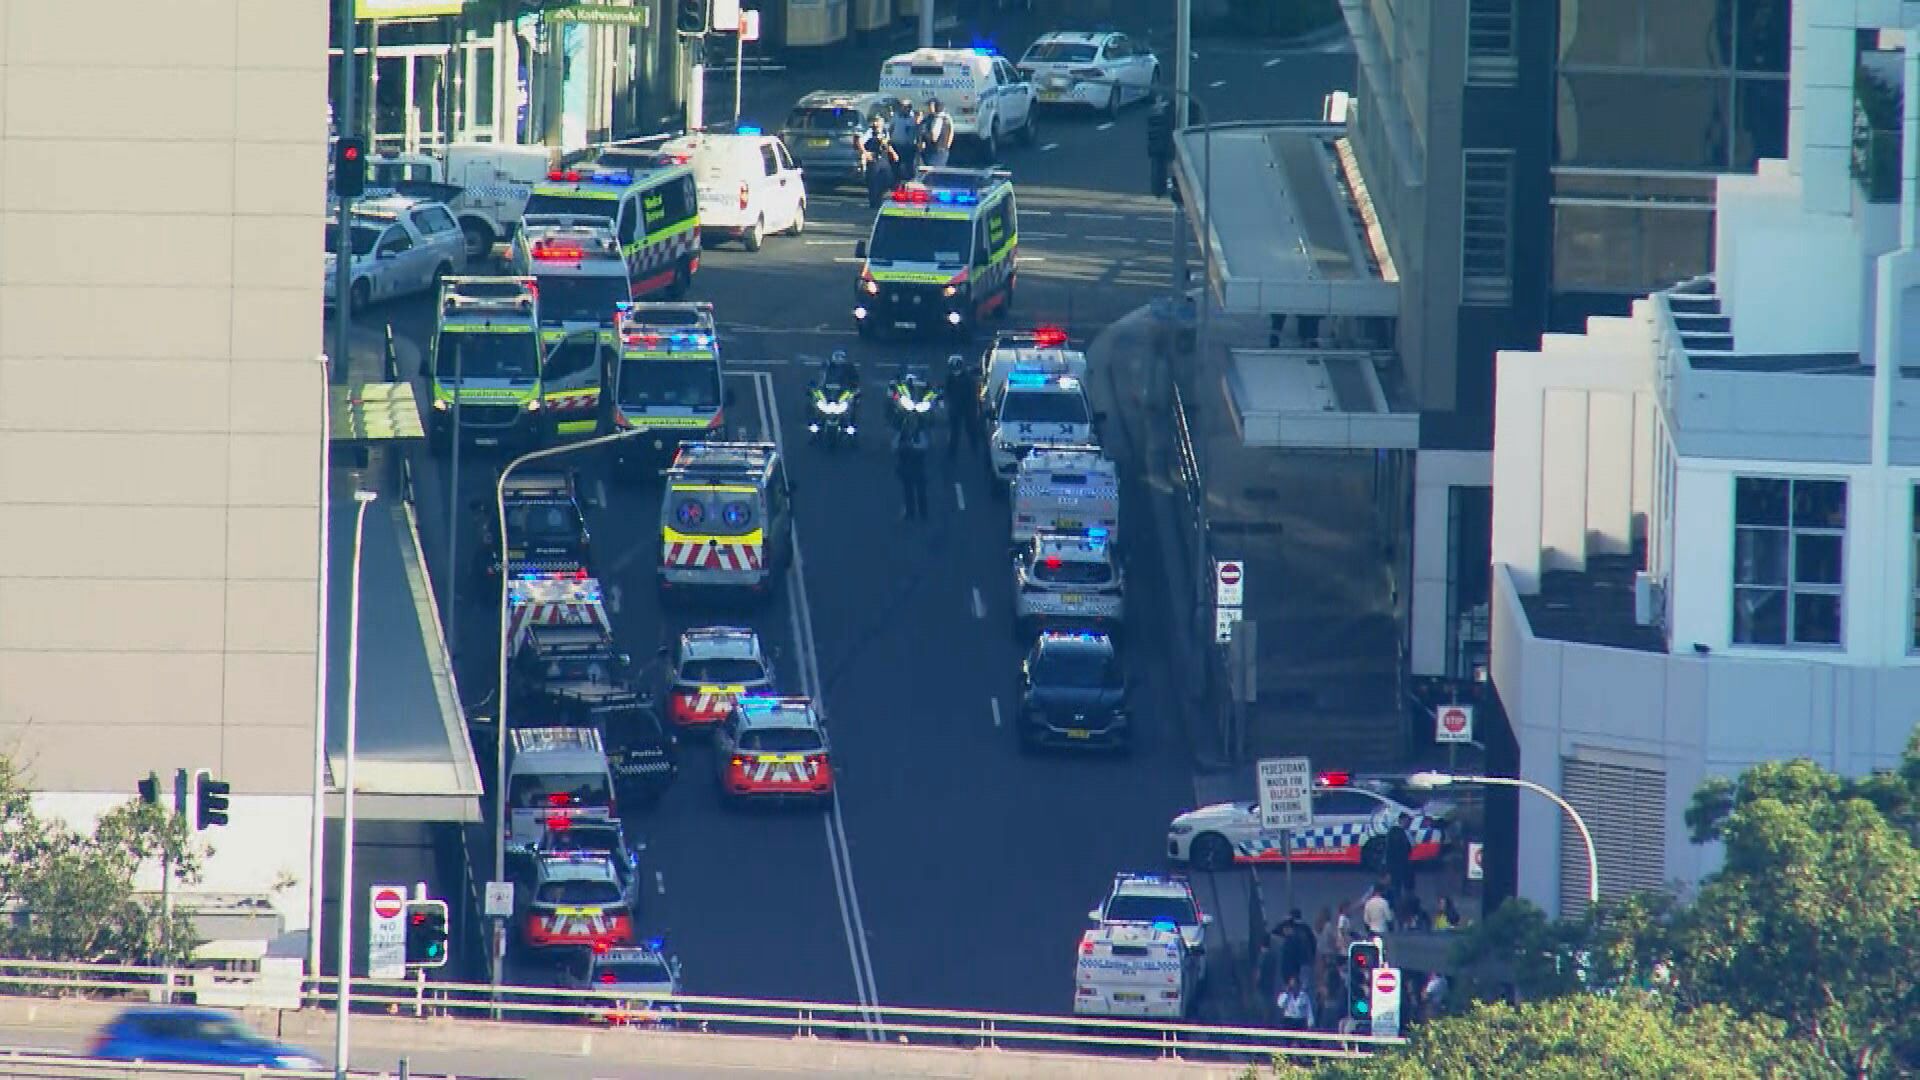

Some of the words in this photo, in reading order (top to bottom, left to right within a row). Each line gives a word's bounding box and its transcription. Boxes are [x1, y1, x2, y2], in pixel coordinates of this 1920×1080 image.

[577, 9, 640, 22] Kathmandu
[1446, 716, 1465, 725] STOP
[1261, 763, 1307, 775] PEDESTRIANS
[1266, 777, 1288, 787] WATCH
[1289, 776, 1303, 786] FOR
[1270, 788, 1301, 800] BUSES
[1271, 801, 1302, 812] ENTERING
[1266, 815, 1280, 825] AND
